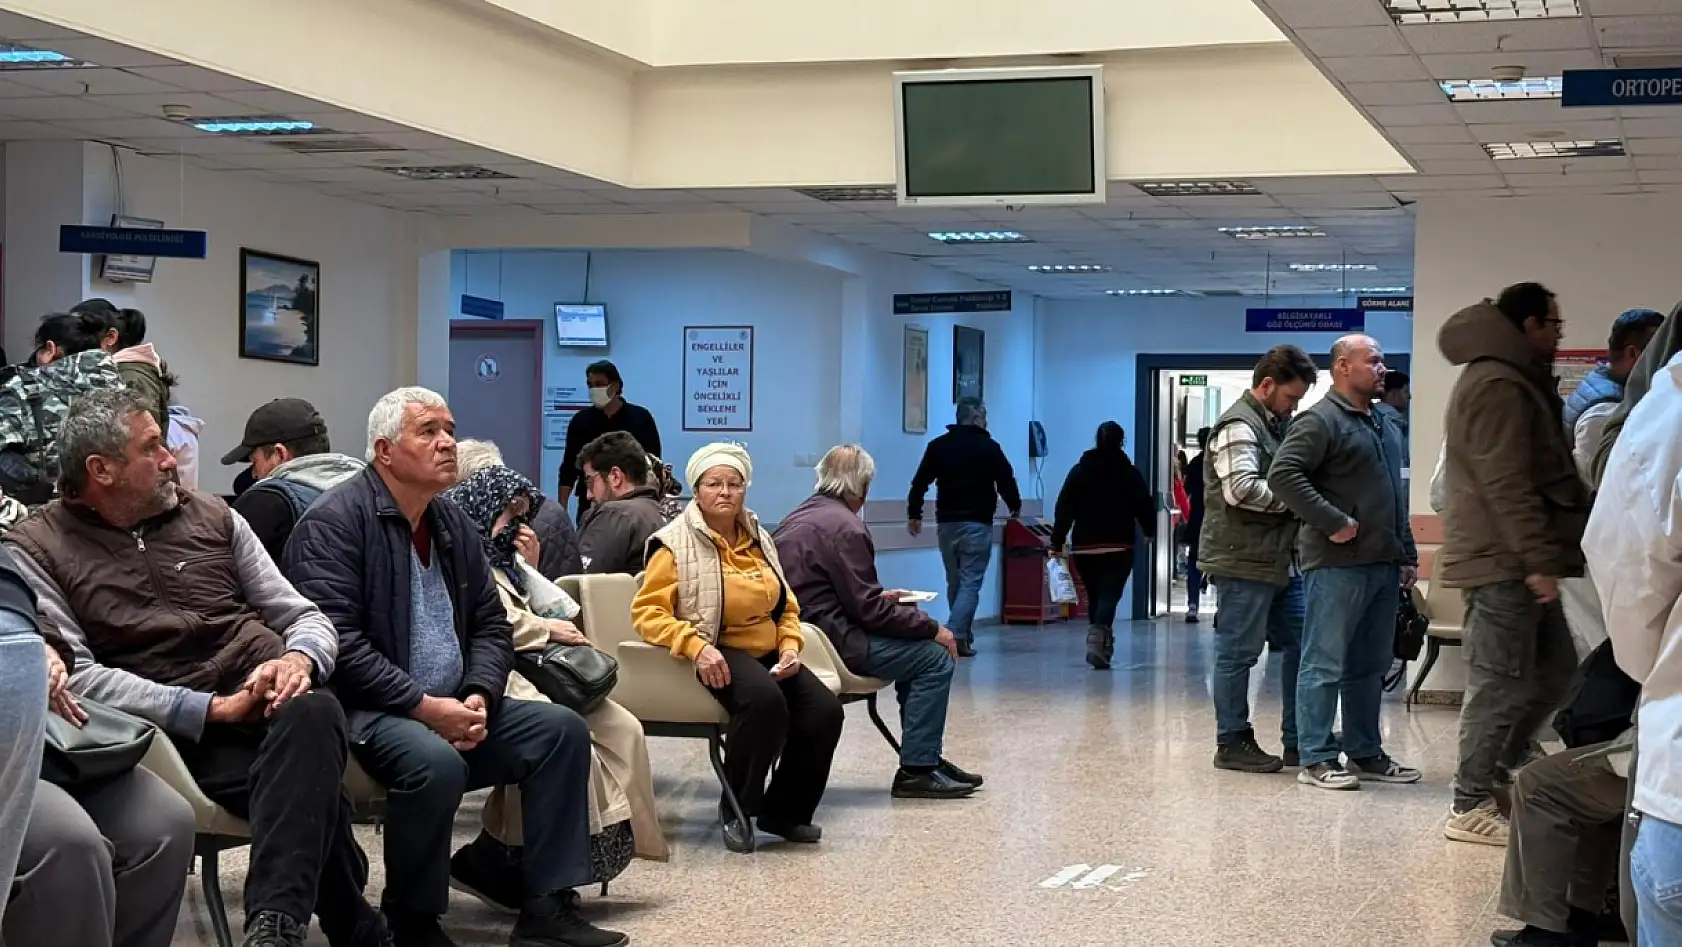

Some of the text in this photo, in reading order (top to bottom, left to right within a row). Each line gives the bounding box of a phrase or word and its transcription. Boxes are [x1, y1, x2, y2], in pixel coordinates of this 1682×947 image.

[1612, 78, 1682, 97] ORTOPE
[691, 341, 744, 352] ENGELLİLER
[712, 355, 723, 364] VE
[696, 368, 739, 377] YAŞLILAR
[708, 379, 728, 389] İÇİN
[693, 391, 741, 401] ÖNCELİKLİ
[697, 405, 737, 413] BEKLEME
[706, 416, 728, 426] YERİ
